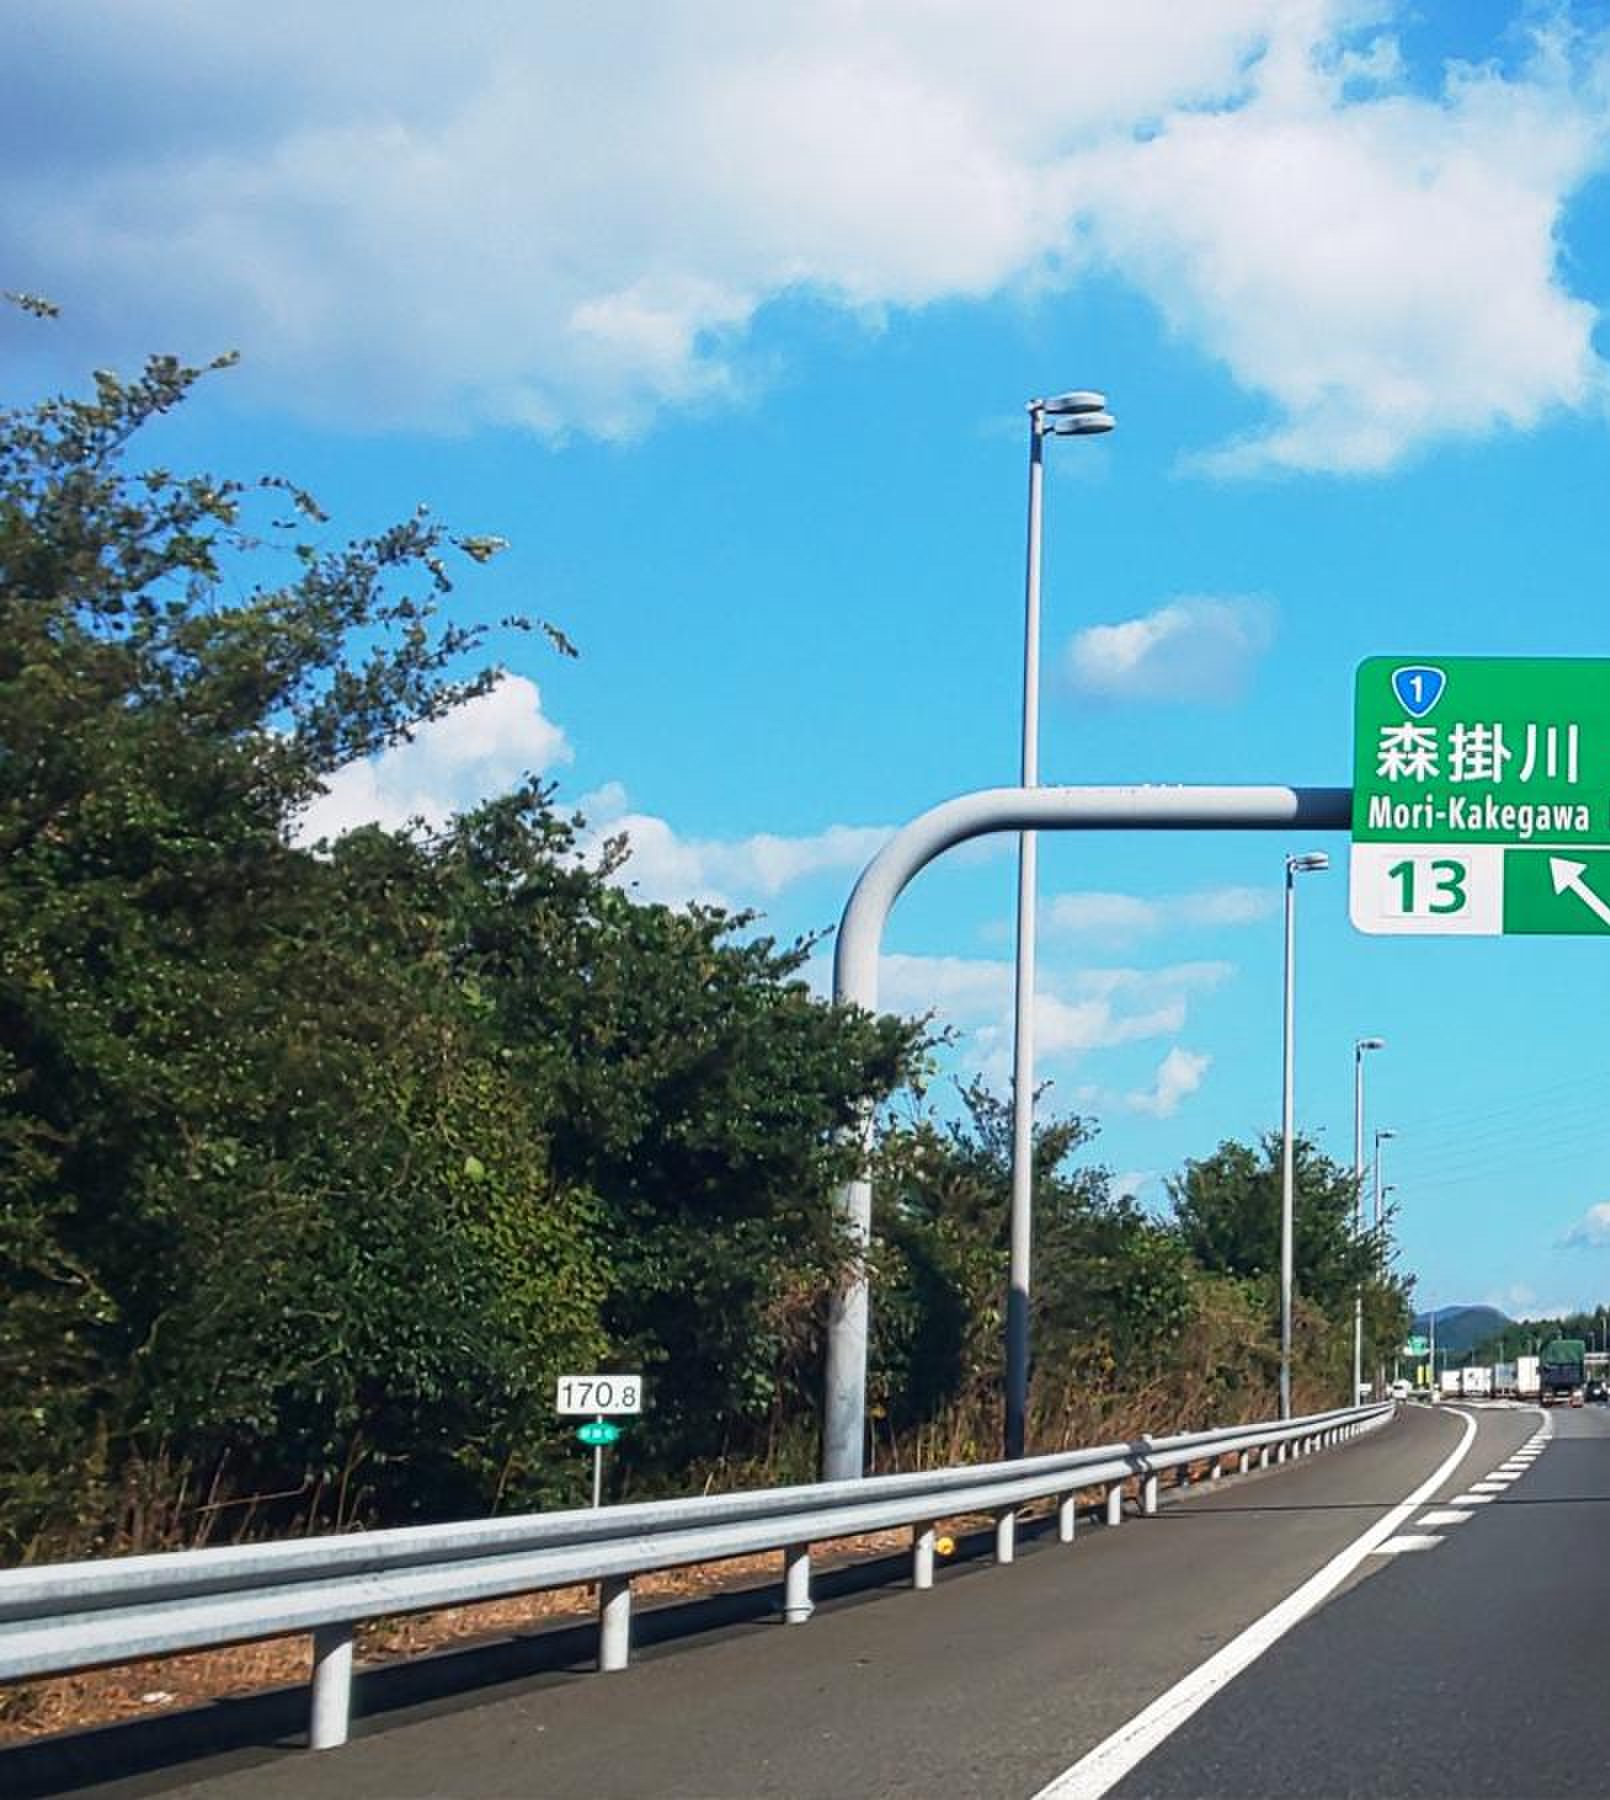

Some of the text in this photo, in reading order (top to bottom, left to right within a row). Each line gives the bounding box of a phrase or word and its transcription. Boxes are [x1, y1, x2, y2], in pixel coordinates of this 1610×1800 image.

[1409, 675, 1423, 703] 1
[1376, 722, 1578, 783] 森掛川
[1369, 795, 1589, 839] Mori-Kakegawa
[1388, 859, 1467, 914] 13
[562, 1381, 636, 1409] 170.8
